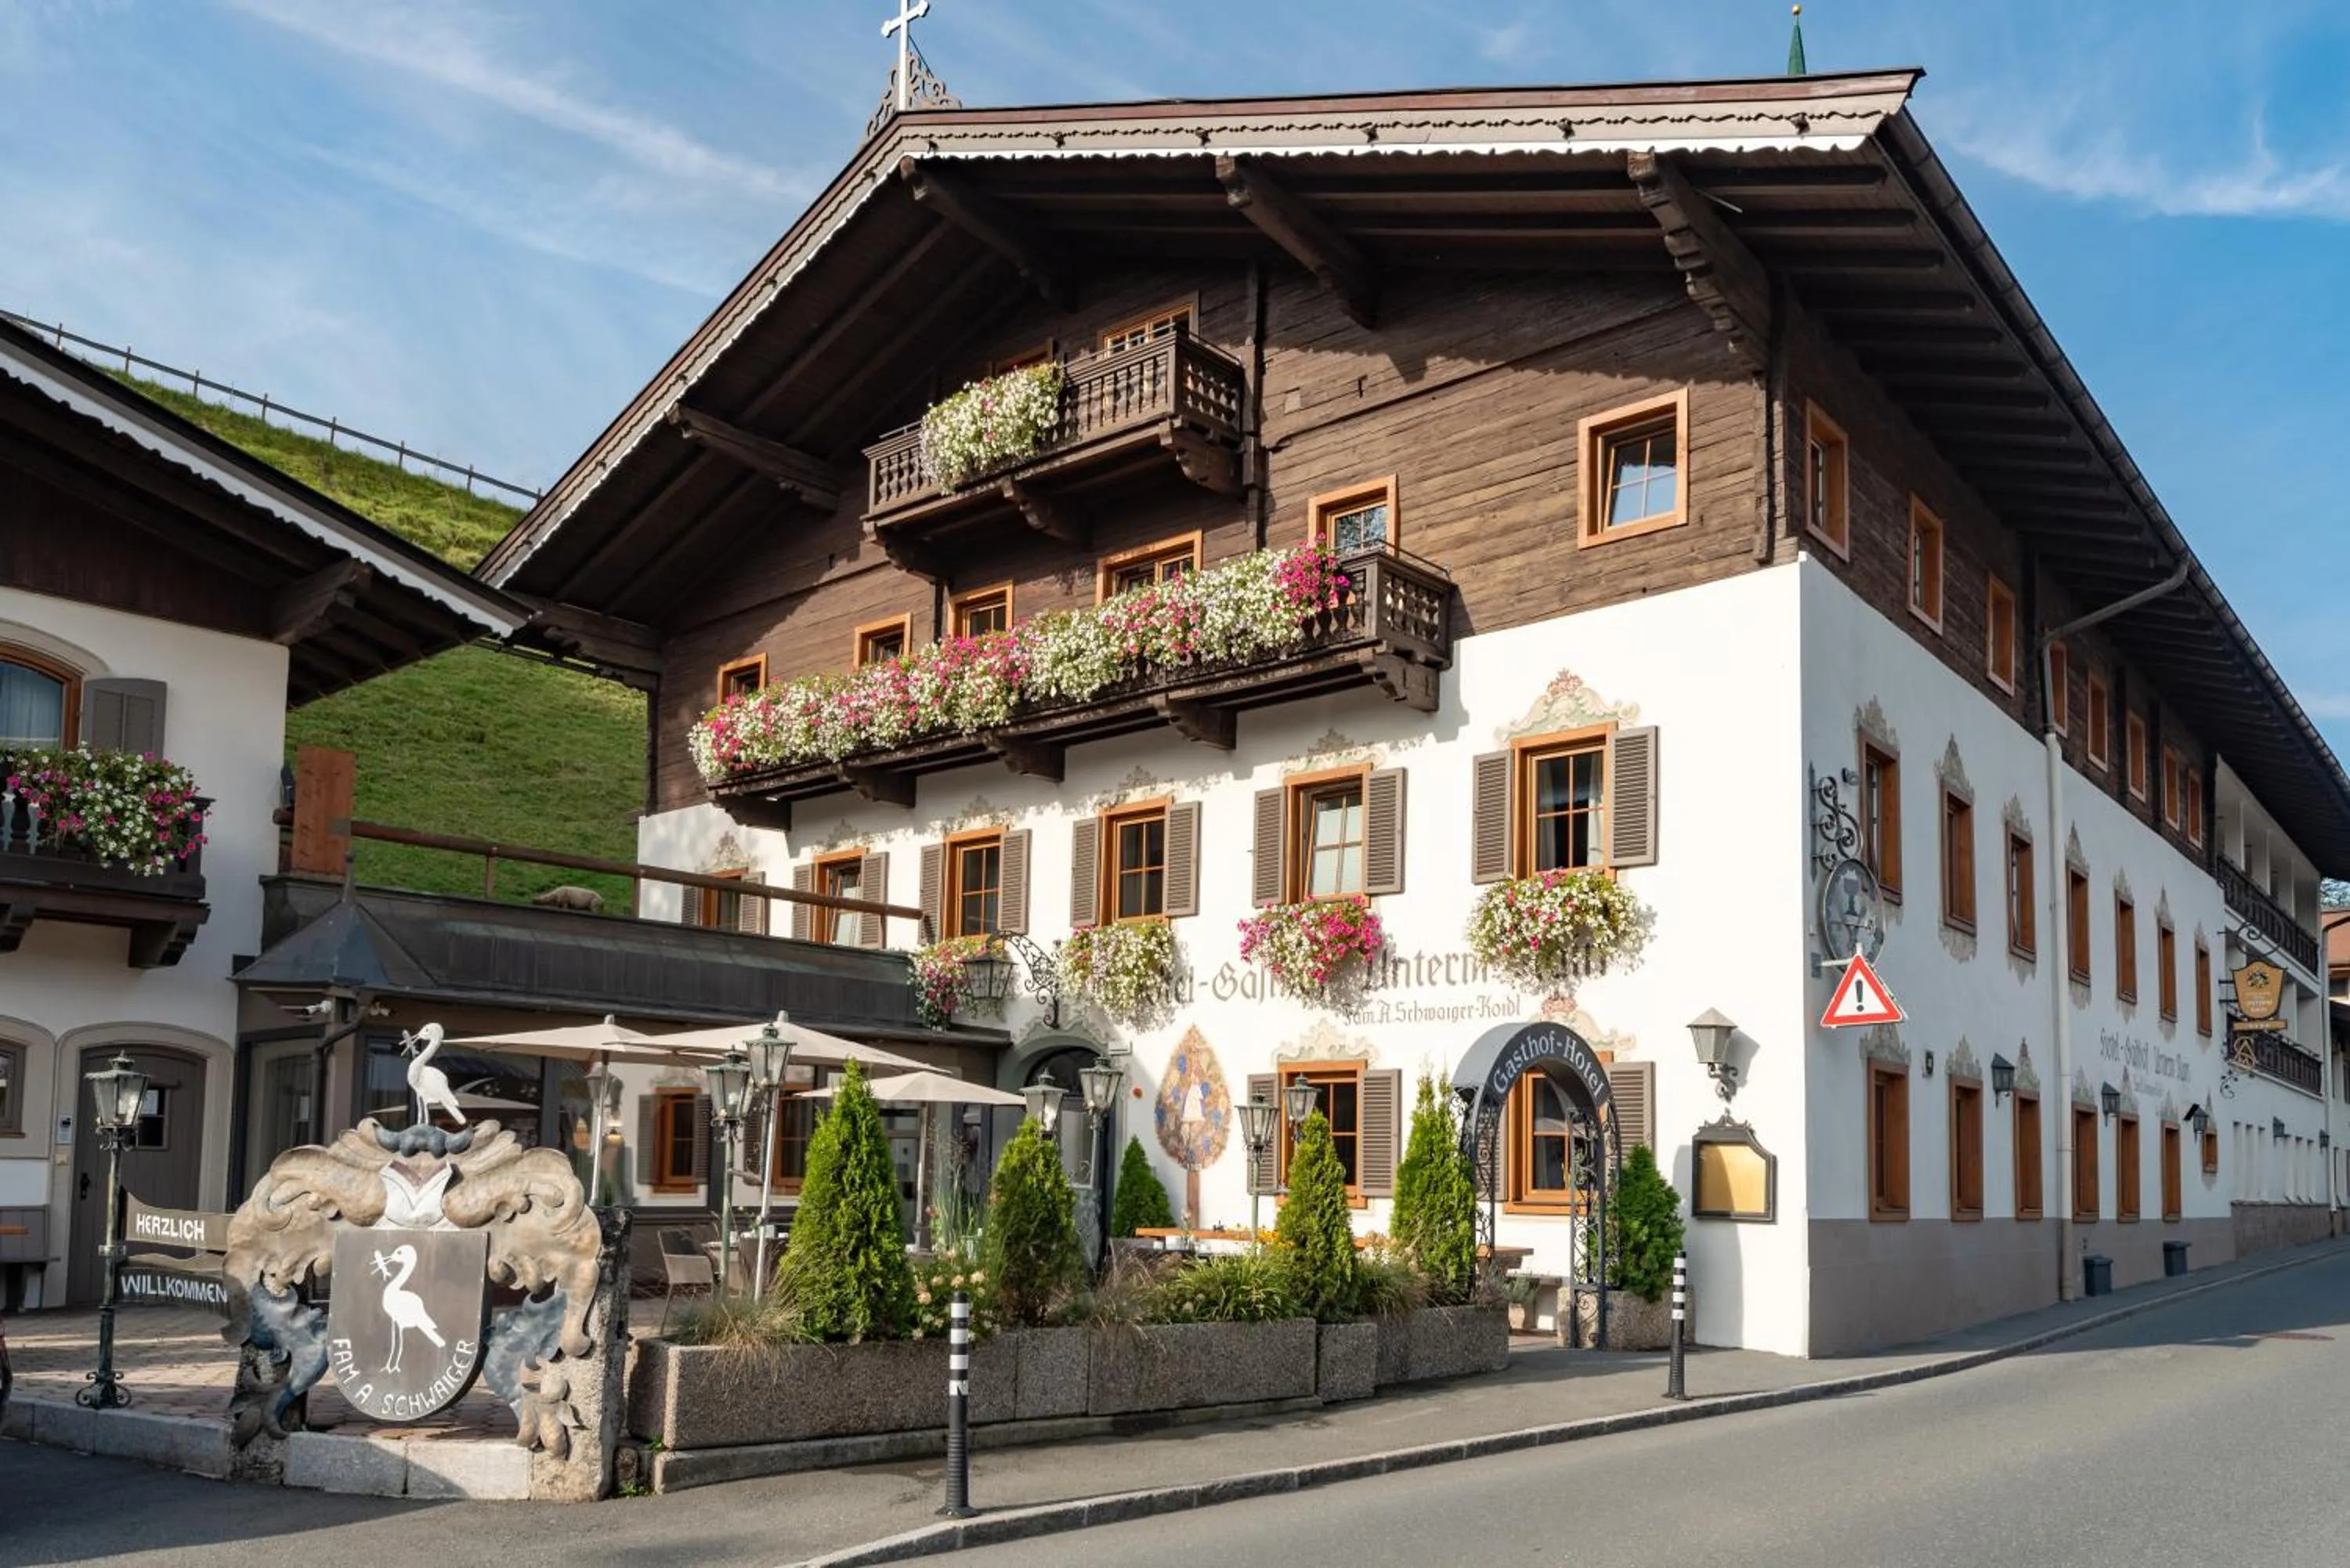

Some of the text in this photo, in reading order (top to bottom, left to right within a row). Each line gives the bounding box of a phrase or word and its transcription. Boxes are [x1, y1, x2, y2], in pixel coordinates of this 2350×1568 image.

[1493, 1030, 1605, 1097] Gasthof-Hotel
[136, 1213, 205, 1241] HERZLICH
[121, 1274, 229, 1303] WILLKOMMEN
[332, 1338, 476, 1416] FAM A SCHWAIGER
